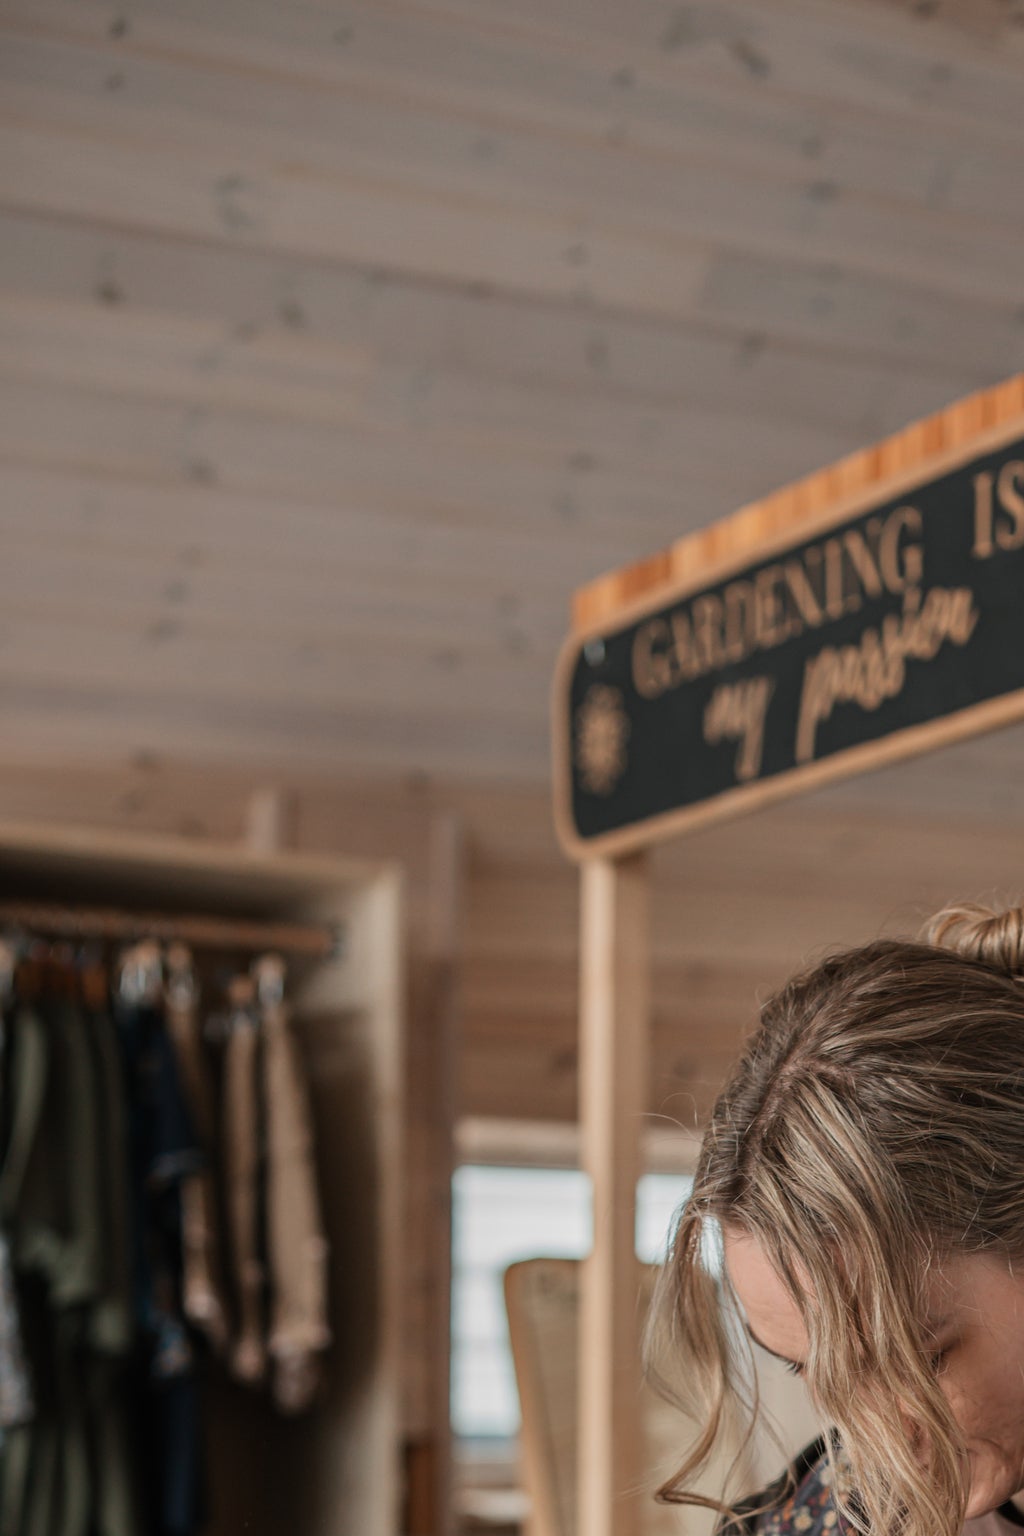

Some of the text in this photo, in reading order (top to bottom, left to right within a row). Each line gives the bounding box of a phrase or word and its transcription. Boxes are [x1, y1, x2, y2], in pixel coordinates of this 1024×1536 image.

[631, 506, 923, 699] GARDENING
[703, 587, 980, 782] my passion
